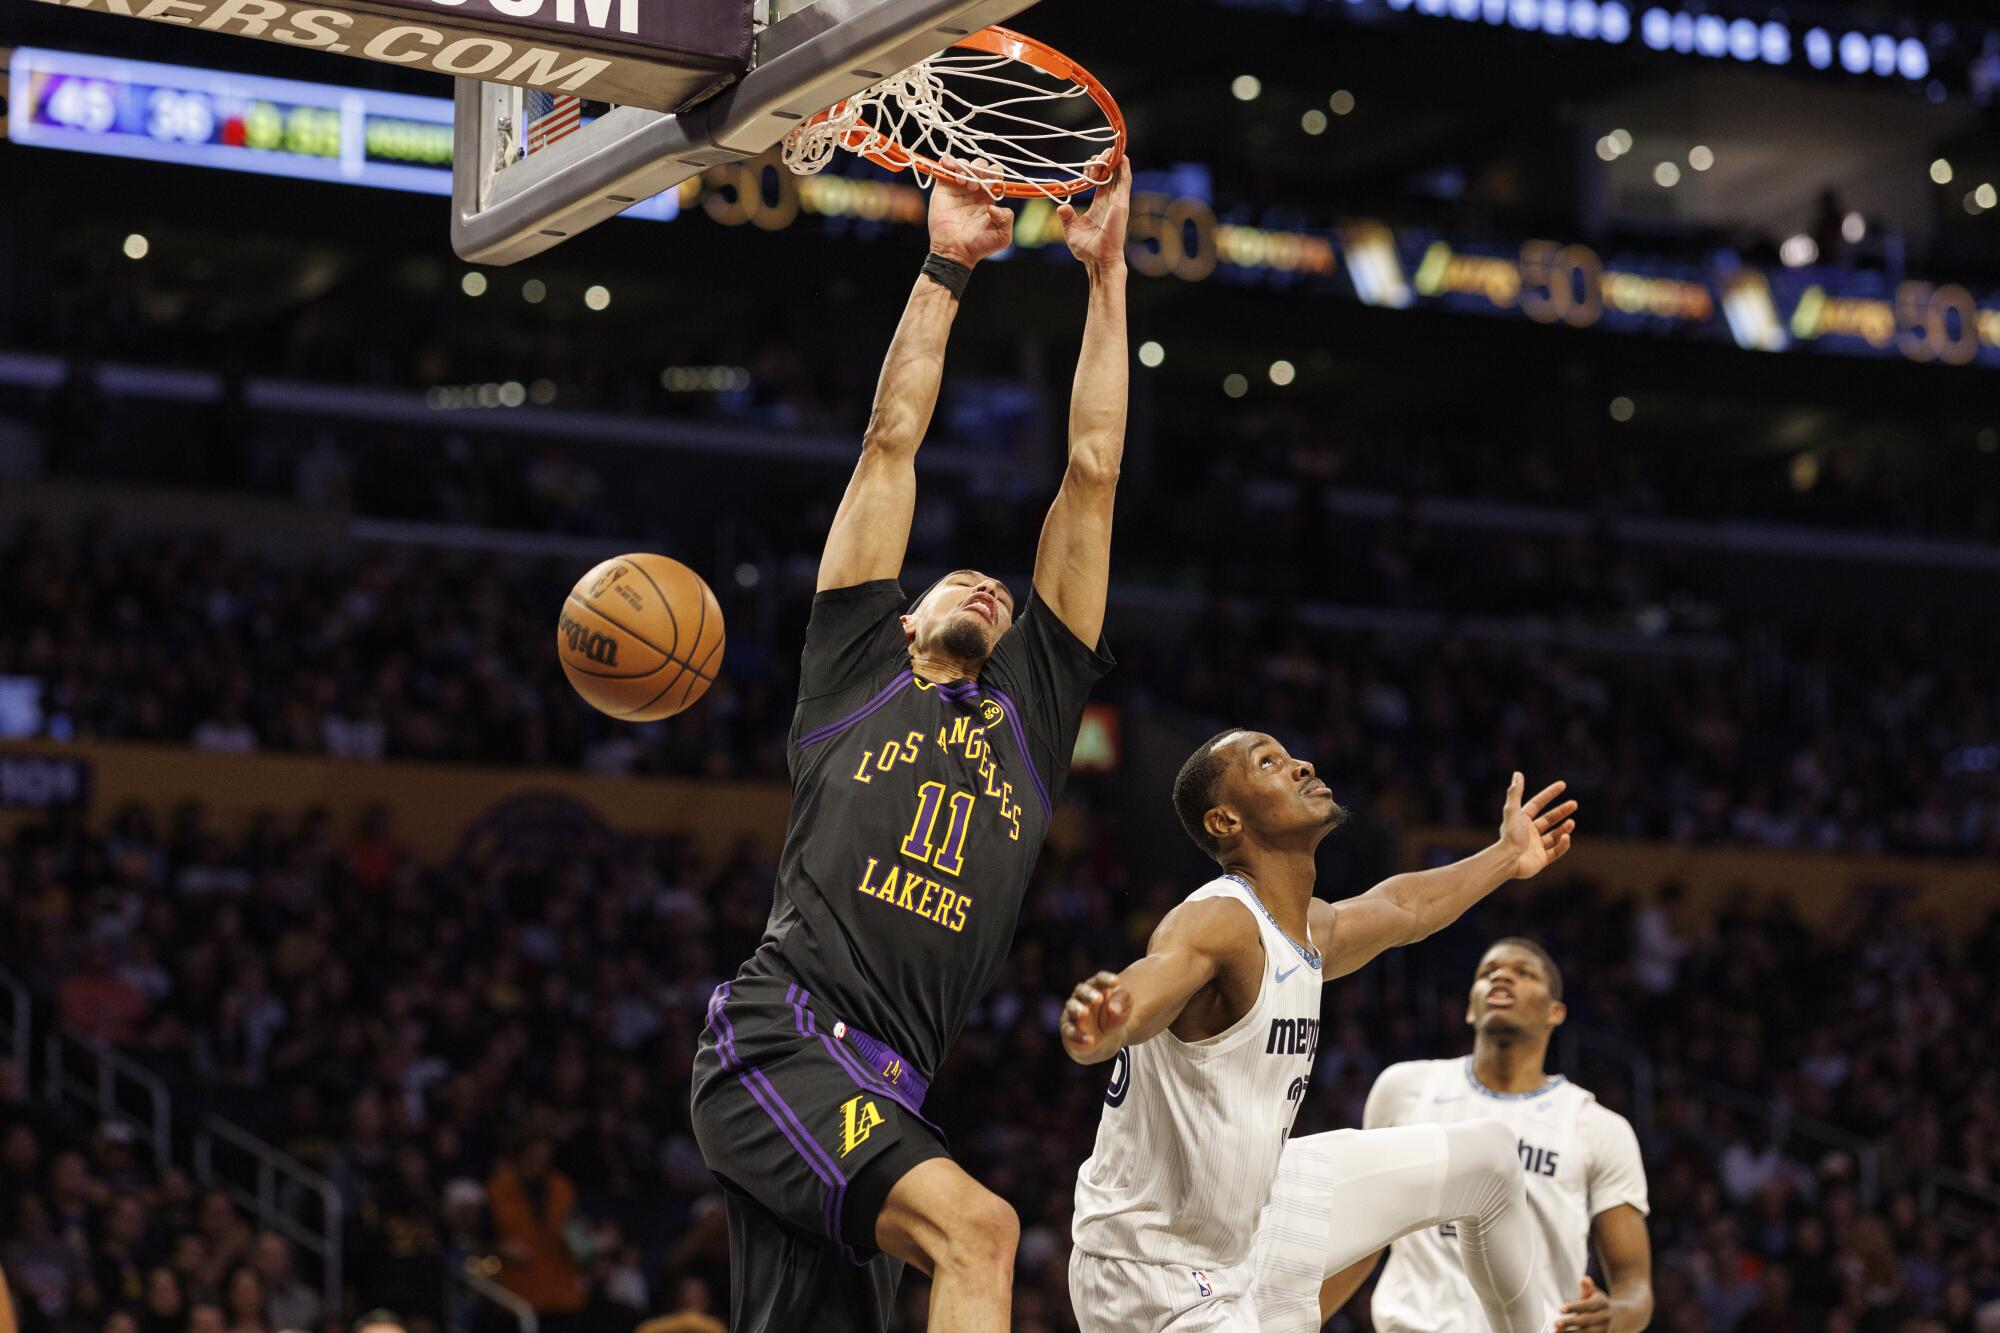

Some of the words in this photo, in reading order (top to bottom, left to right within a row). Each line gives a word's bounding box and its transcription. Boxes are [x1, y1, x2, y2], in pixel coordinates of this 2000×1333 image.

[852, 730, 926, 785] LOS
[936, 715, 1023, 841] ANGELES
[900, 780, 976, 877] 11
[857, 855, 973, 932] LAKERS
[836, 1095, 886, 1159] LA
